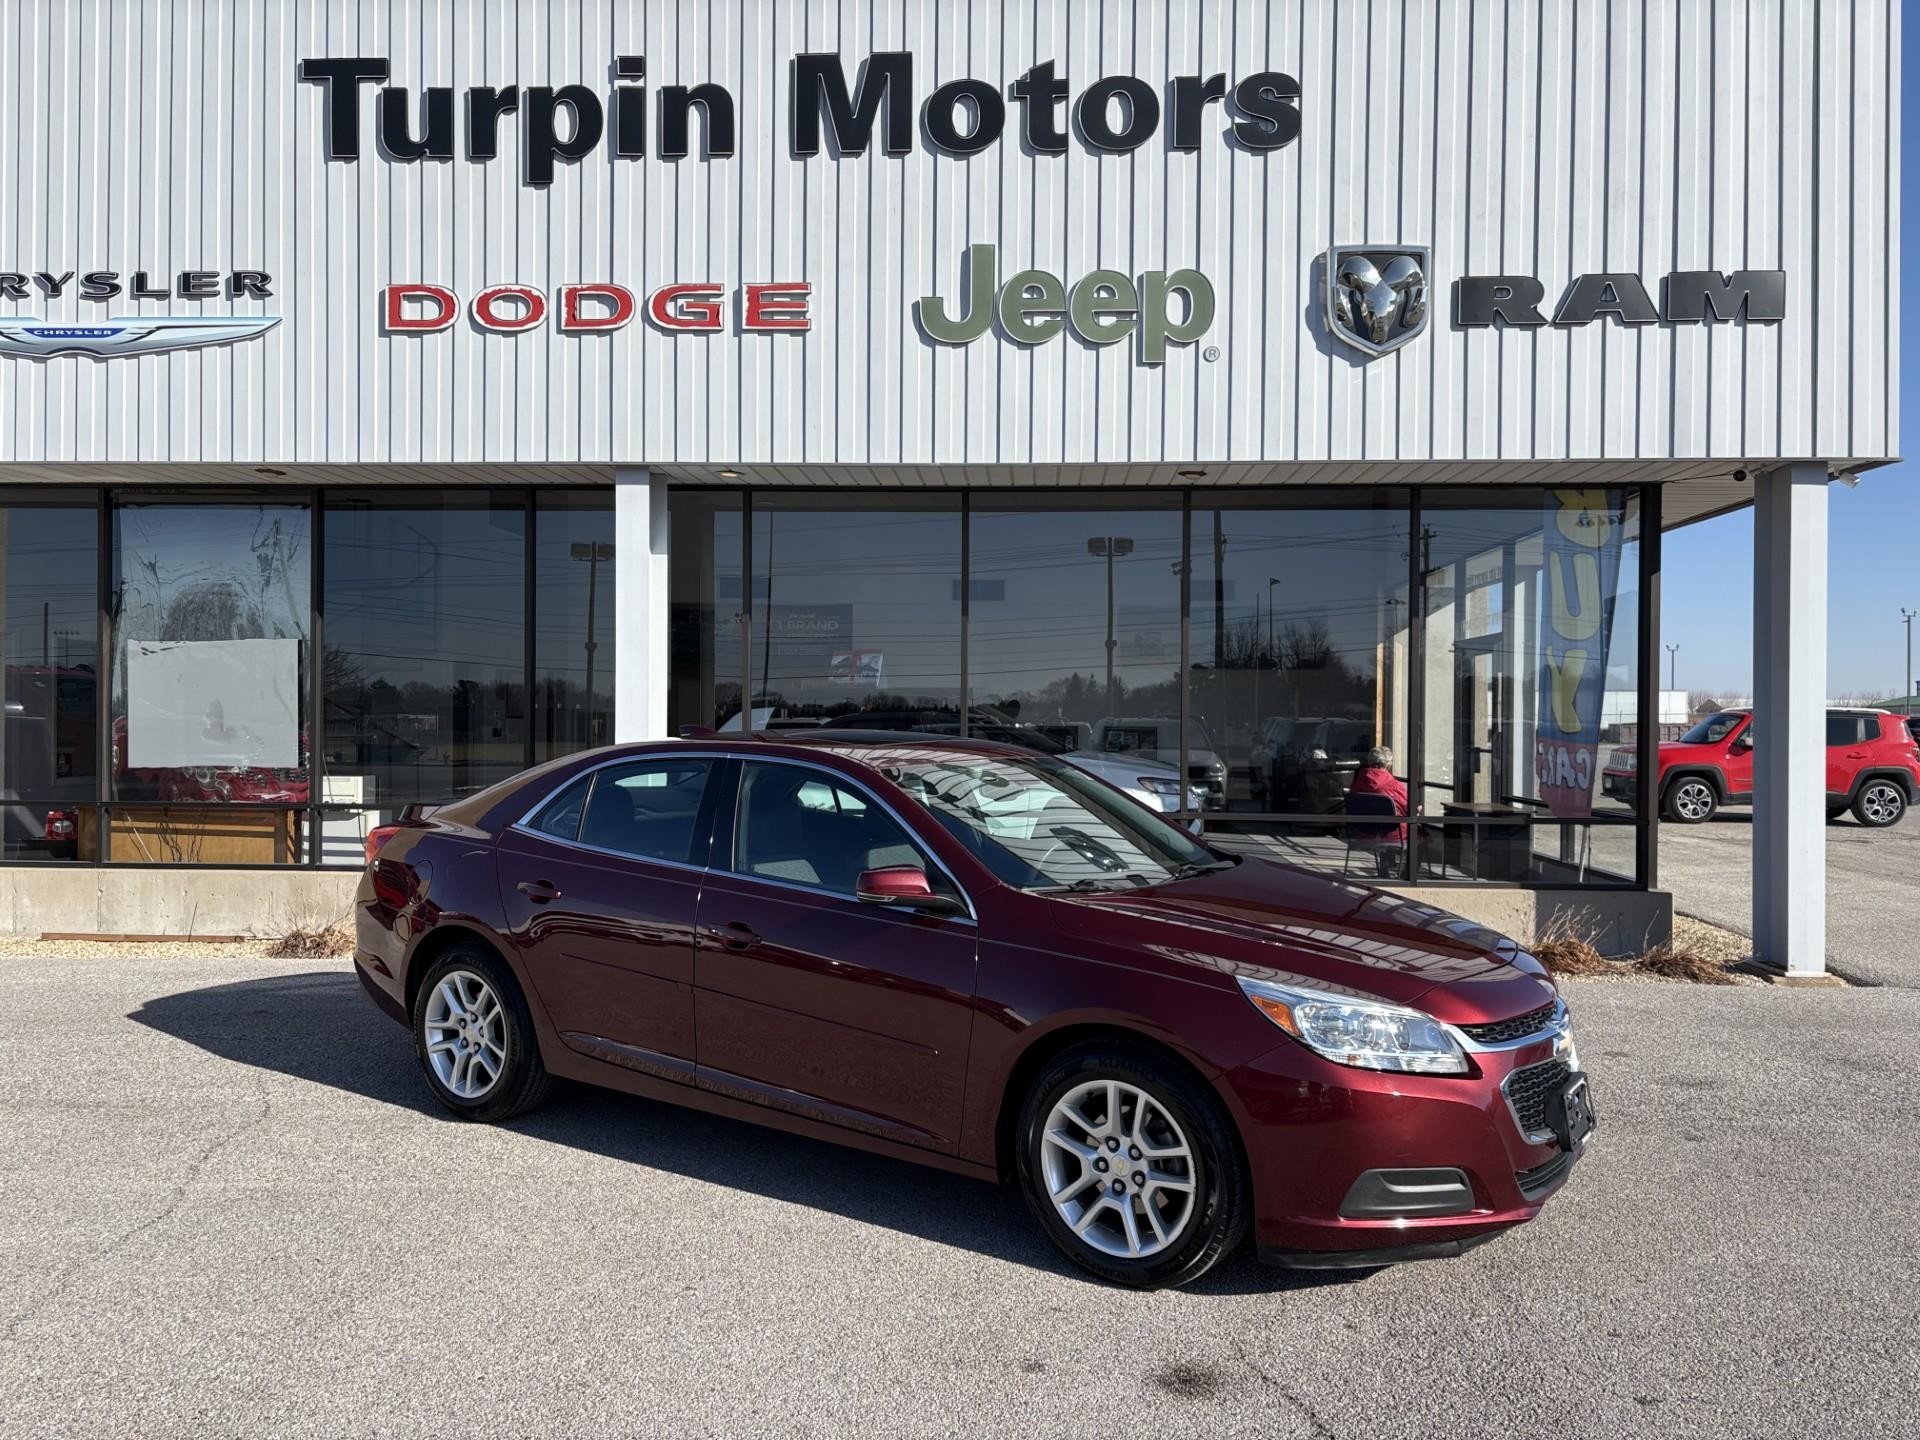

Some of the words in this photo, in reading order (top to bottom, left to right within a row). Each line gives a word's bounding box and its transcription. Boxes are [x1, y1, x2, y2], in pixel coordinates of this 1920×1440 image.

[302, 56, 734, 185] Turpin
[794, 52, 1301, 153] Motors
[385, 282, 812, 332] DODGE
[919, 244, 1215, 363] Jeep
[1457, 270, 1786, 326] RAM
[1099, 1057, 1156, 1081] KUMHO
